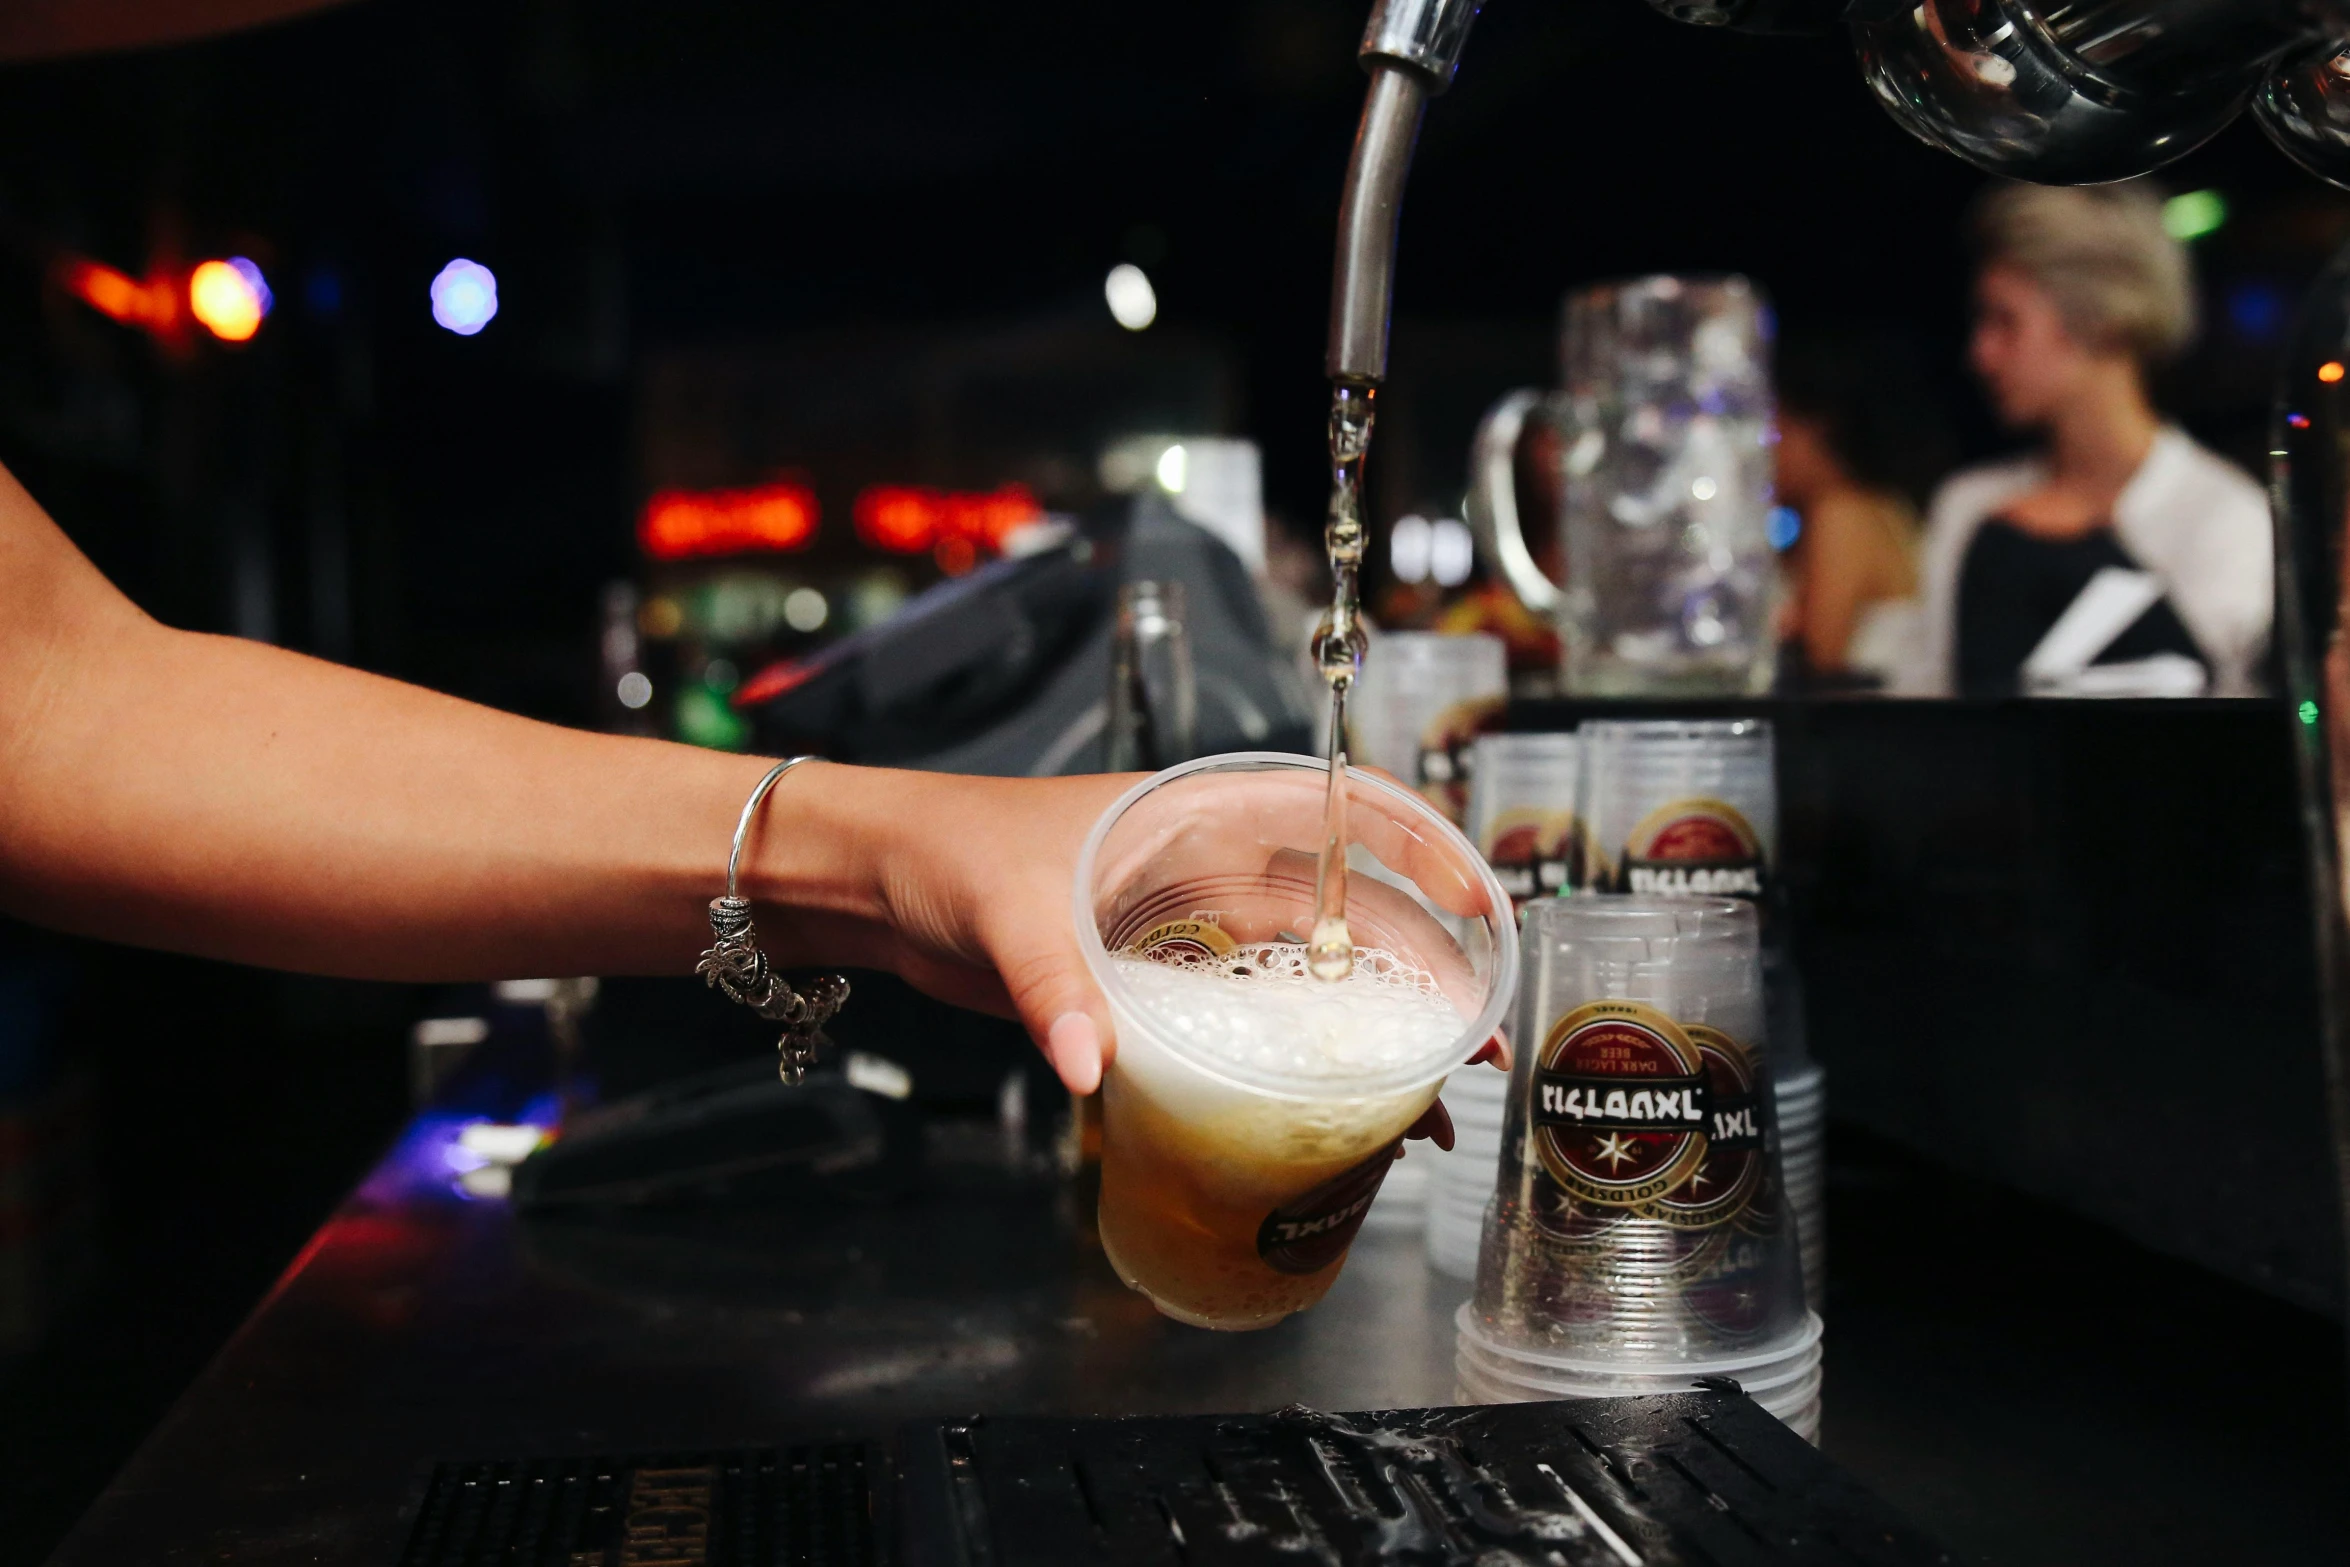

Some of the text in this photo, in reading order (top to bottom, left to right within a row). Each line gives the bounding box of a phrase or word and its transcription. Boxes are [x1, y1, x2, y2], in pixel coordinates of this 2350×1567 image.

[1600, 1047, 1632, 1059] BEER
[1620, 1060, 1658, 1072] DARK
[1542, 1084, 1703, 1122] גולדסטאר
[1565, 1175, 1668, 1201] GOLDSTAR
